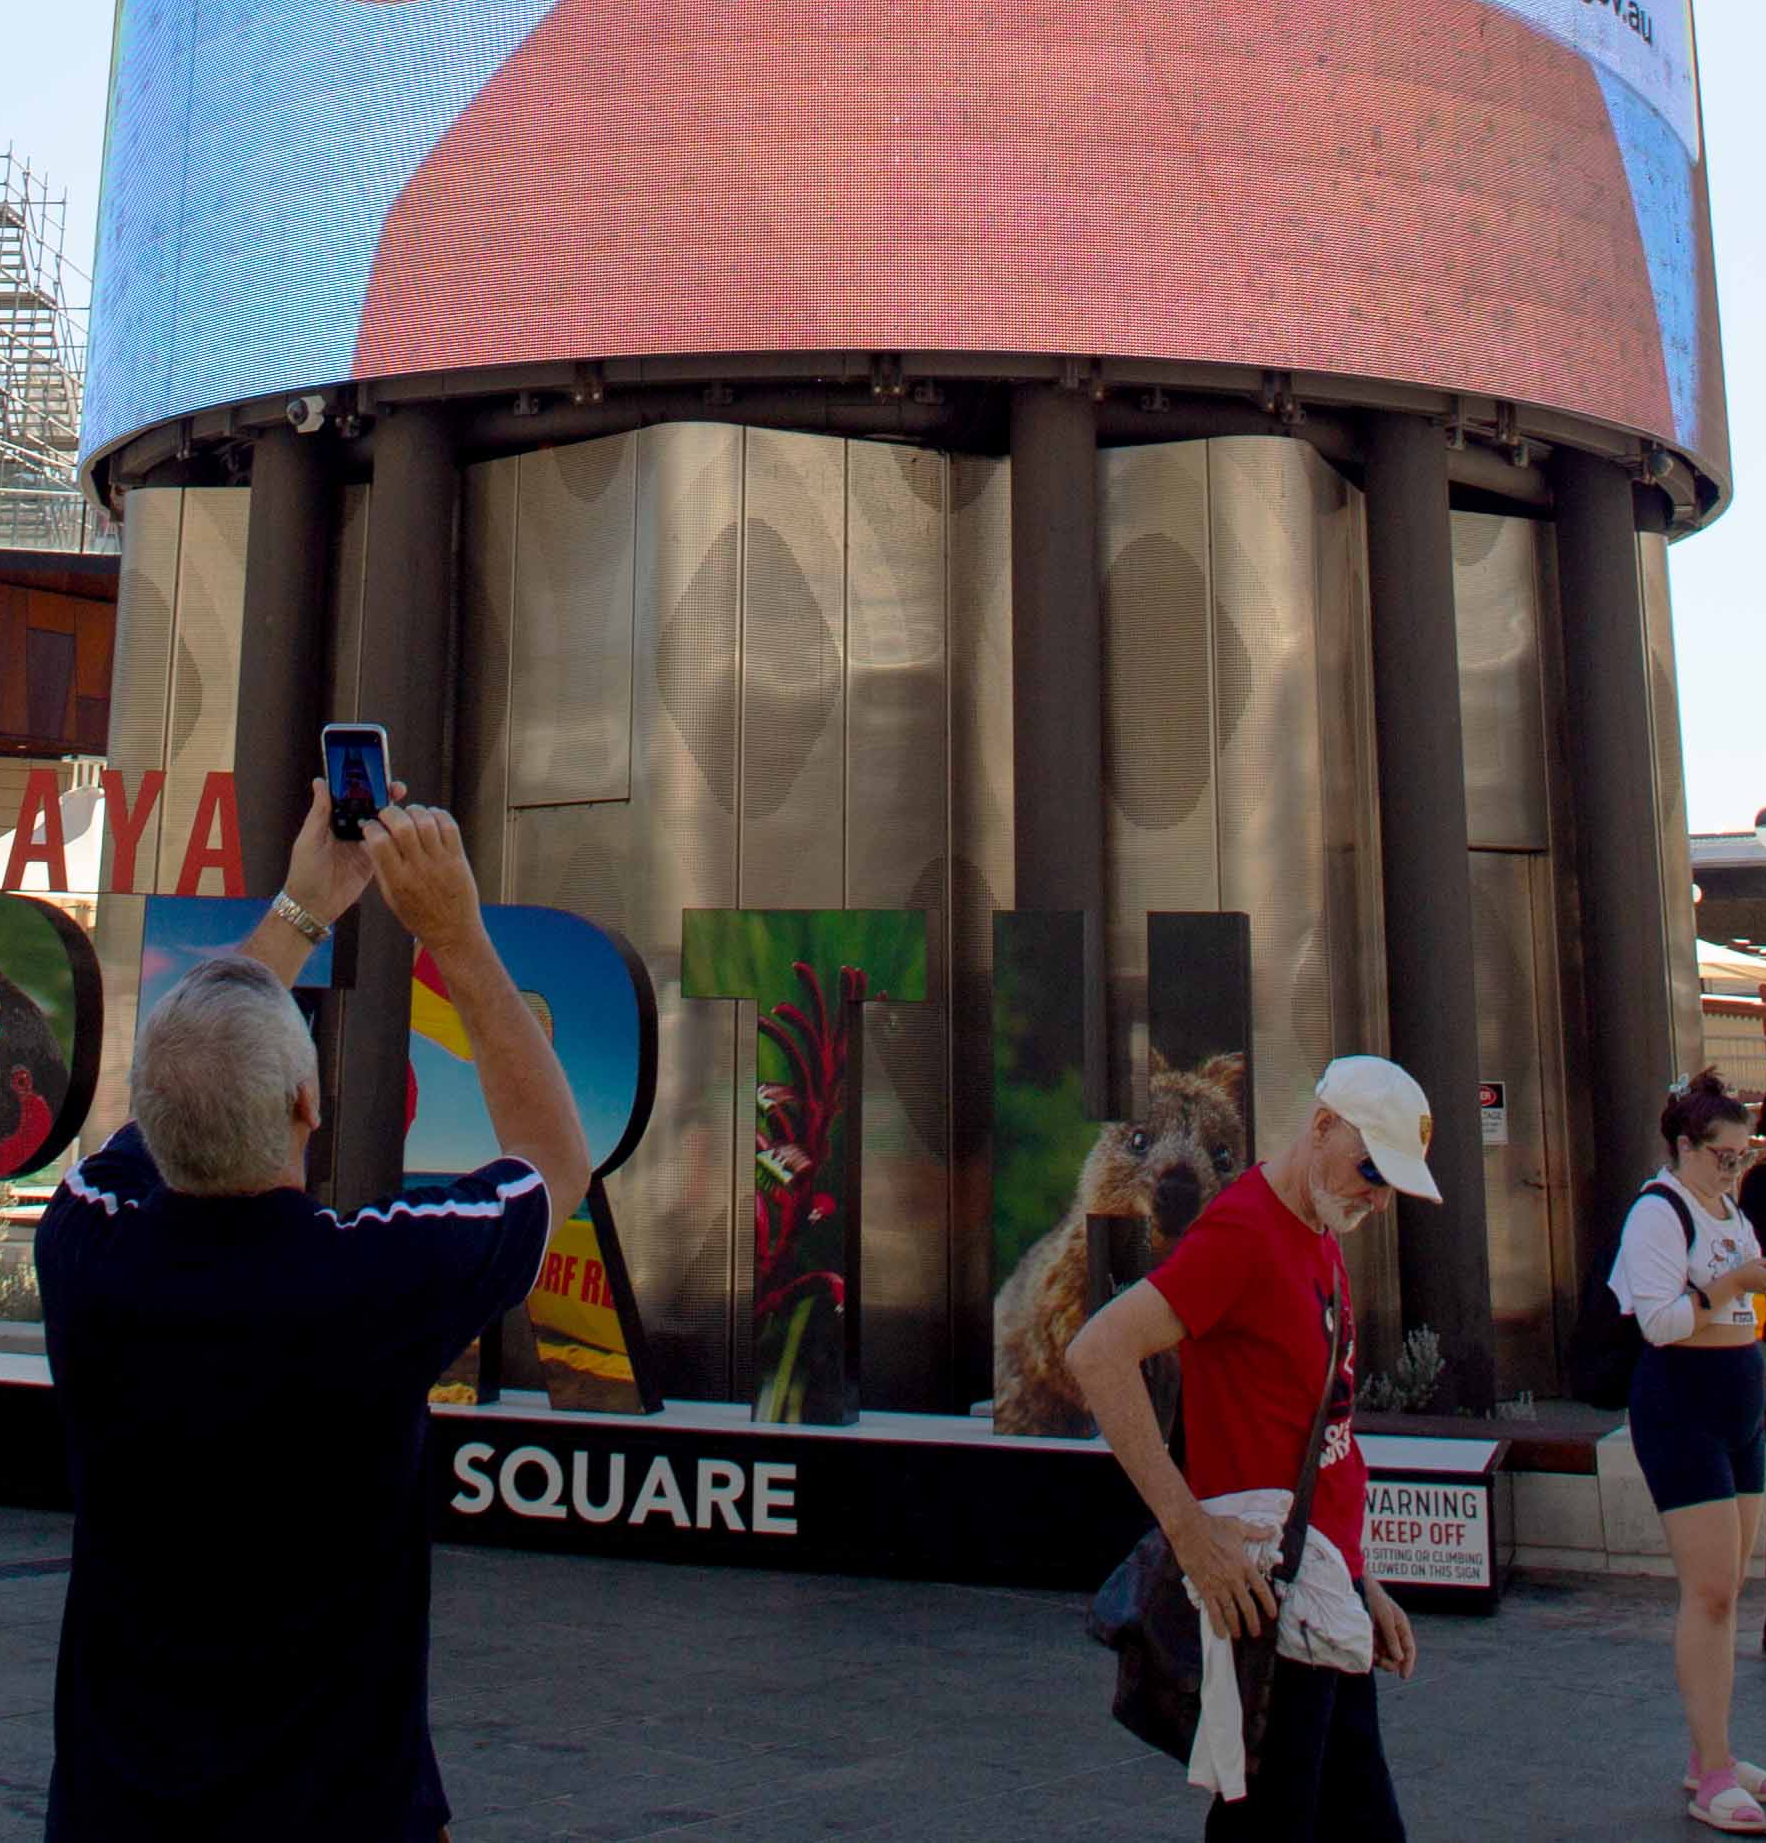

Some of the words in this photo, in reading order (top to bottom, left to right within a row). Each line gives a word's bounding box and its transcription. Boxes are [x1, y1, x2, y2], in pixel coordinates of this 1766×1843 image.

[450, 1441, 798, 1536] SQUARE
[1370, 1519, 1423, 1545] KEEP
[1429, 1522, 1467, 1546] OFF
[1372, 1548, 1413, 1562] SITTING
[1415, 1549, 1430, 1562] OR
[1432, 1550, 1483, 1566] CLIMBING
[1411, 1563, 1426, 1576] ON
[1429, 1564, 1453, 1578] THIS
[1455, 1566, 1481, 1580] SIGN
